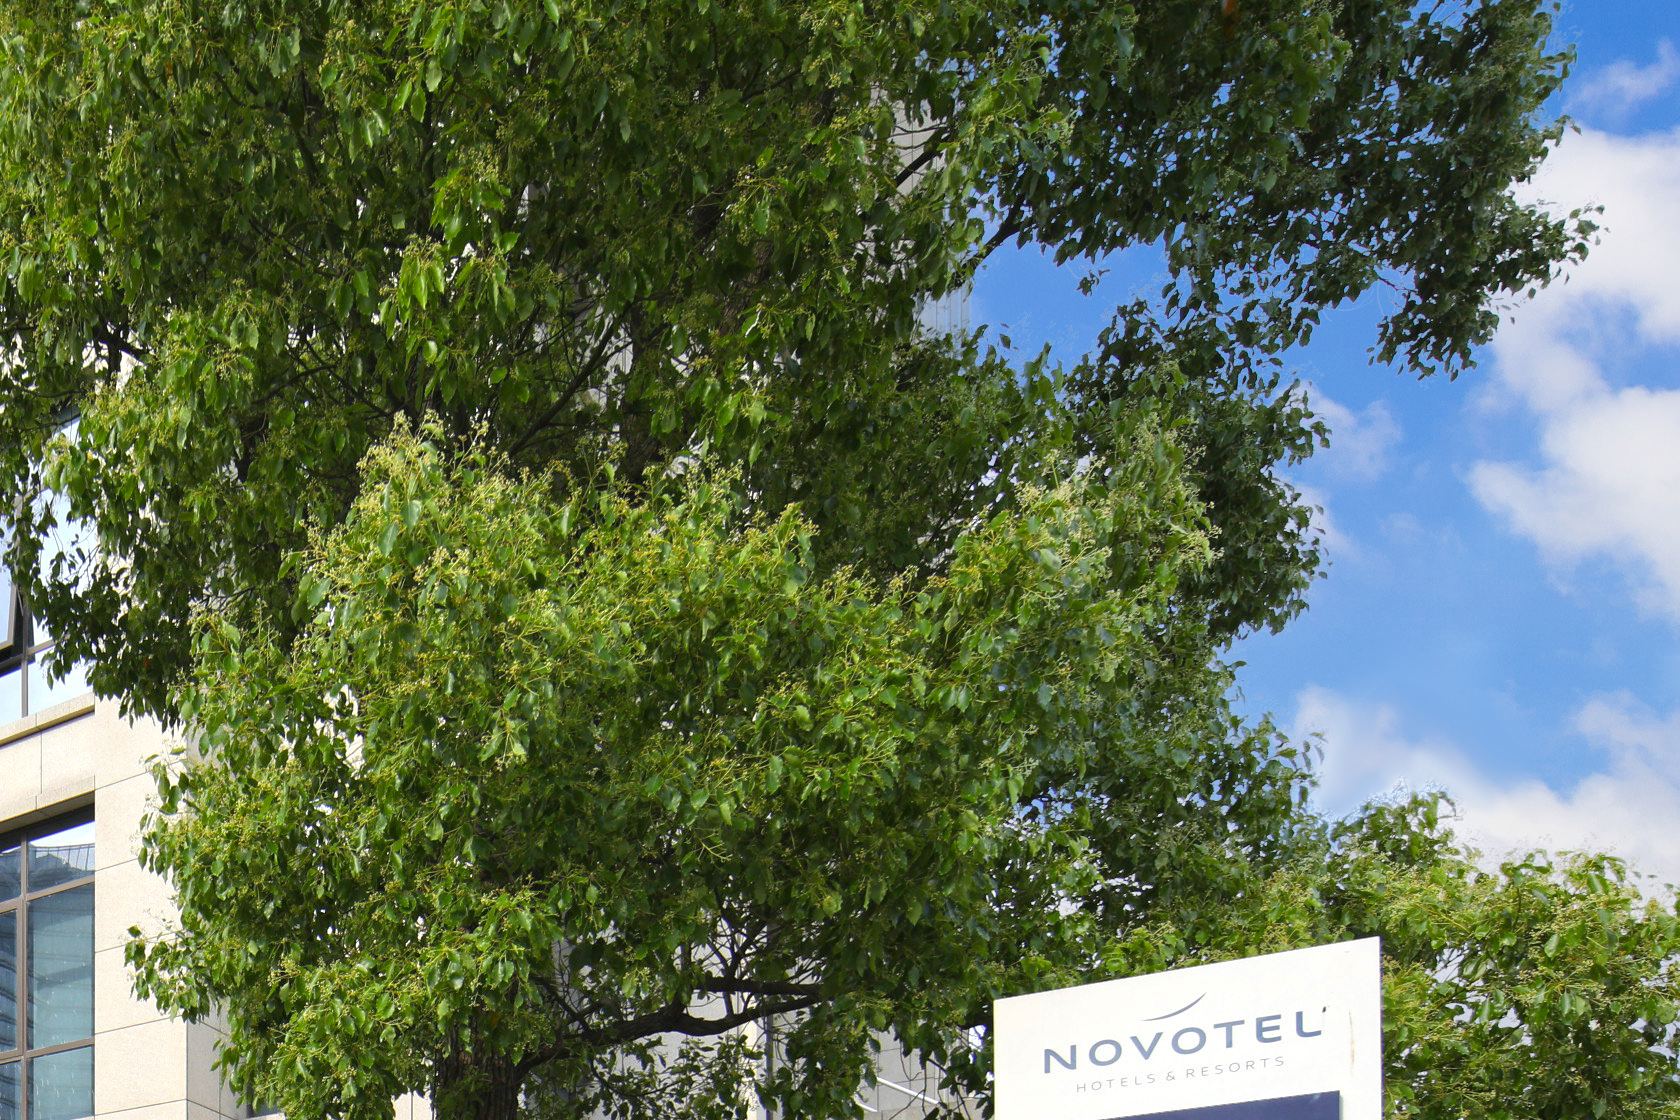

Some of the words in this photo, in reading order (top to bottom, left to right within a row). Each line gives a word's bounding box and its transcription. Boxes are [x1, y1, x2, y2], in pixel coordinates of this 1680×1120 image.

[1043, 1010, 1322, 1074] NOVOTEL
[1076, 1073, 1156, 1094] HOTELS
[1165, 1070, 1177, 1082] &
[1185, 1055, 1286, 1079] RESORTS
